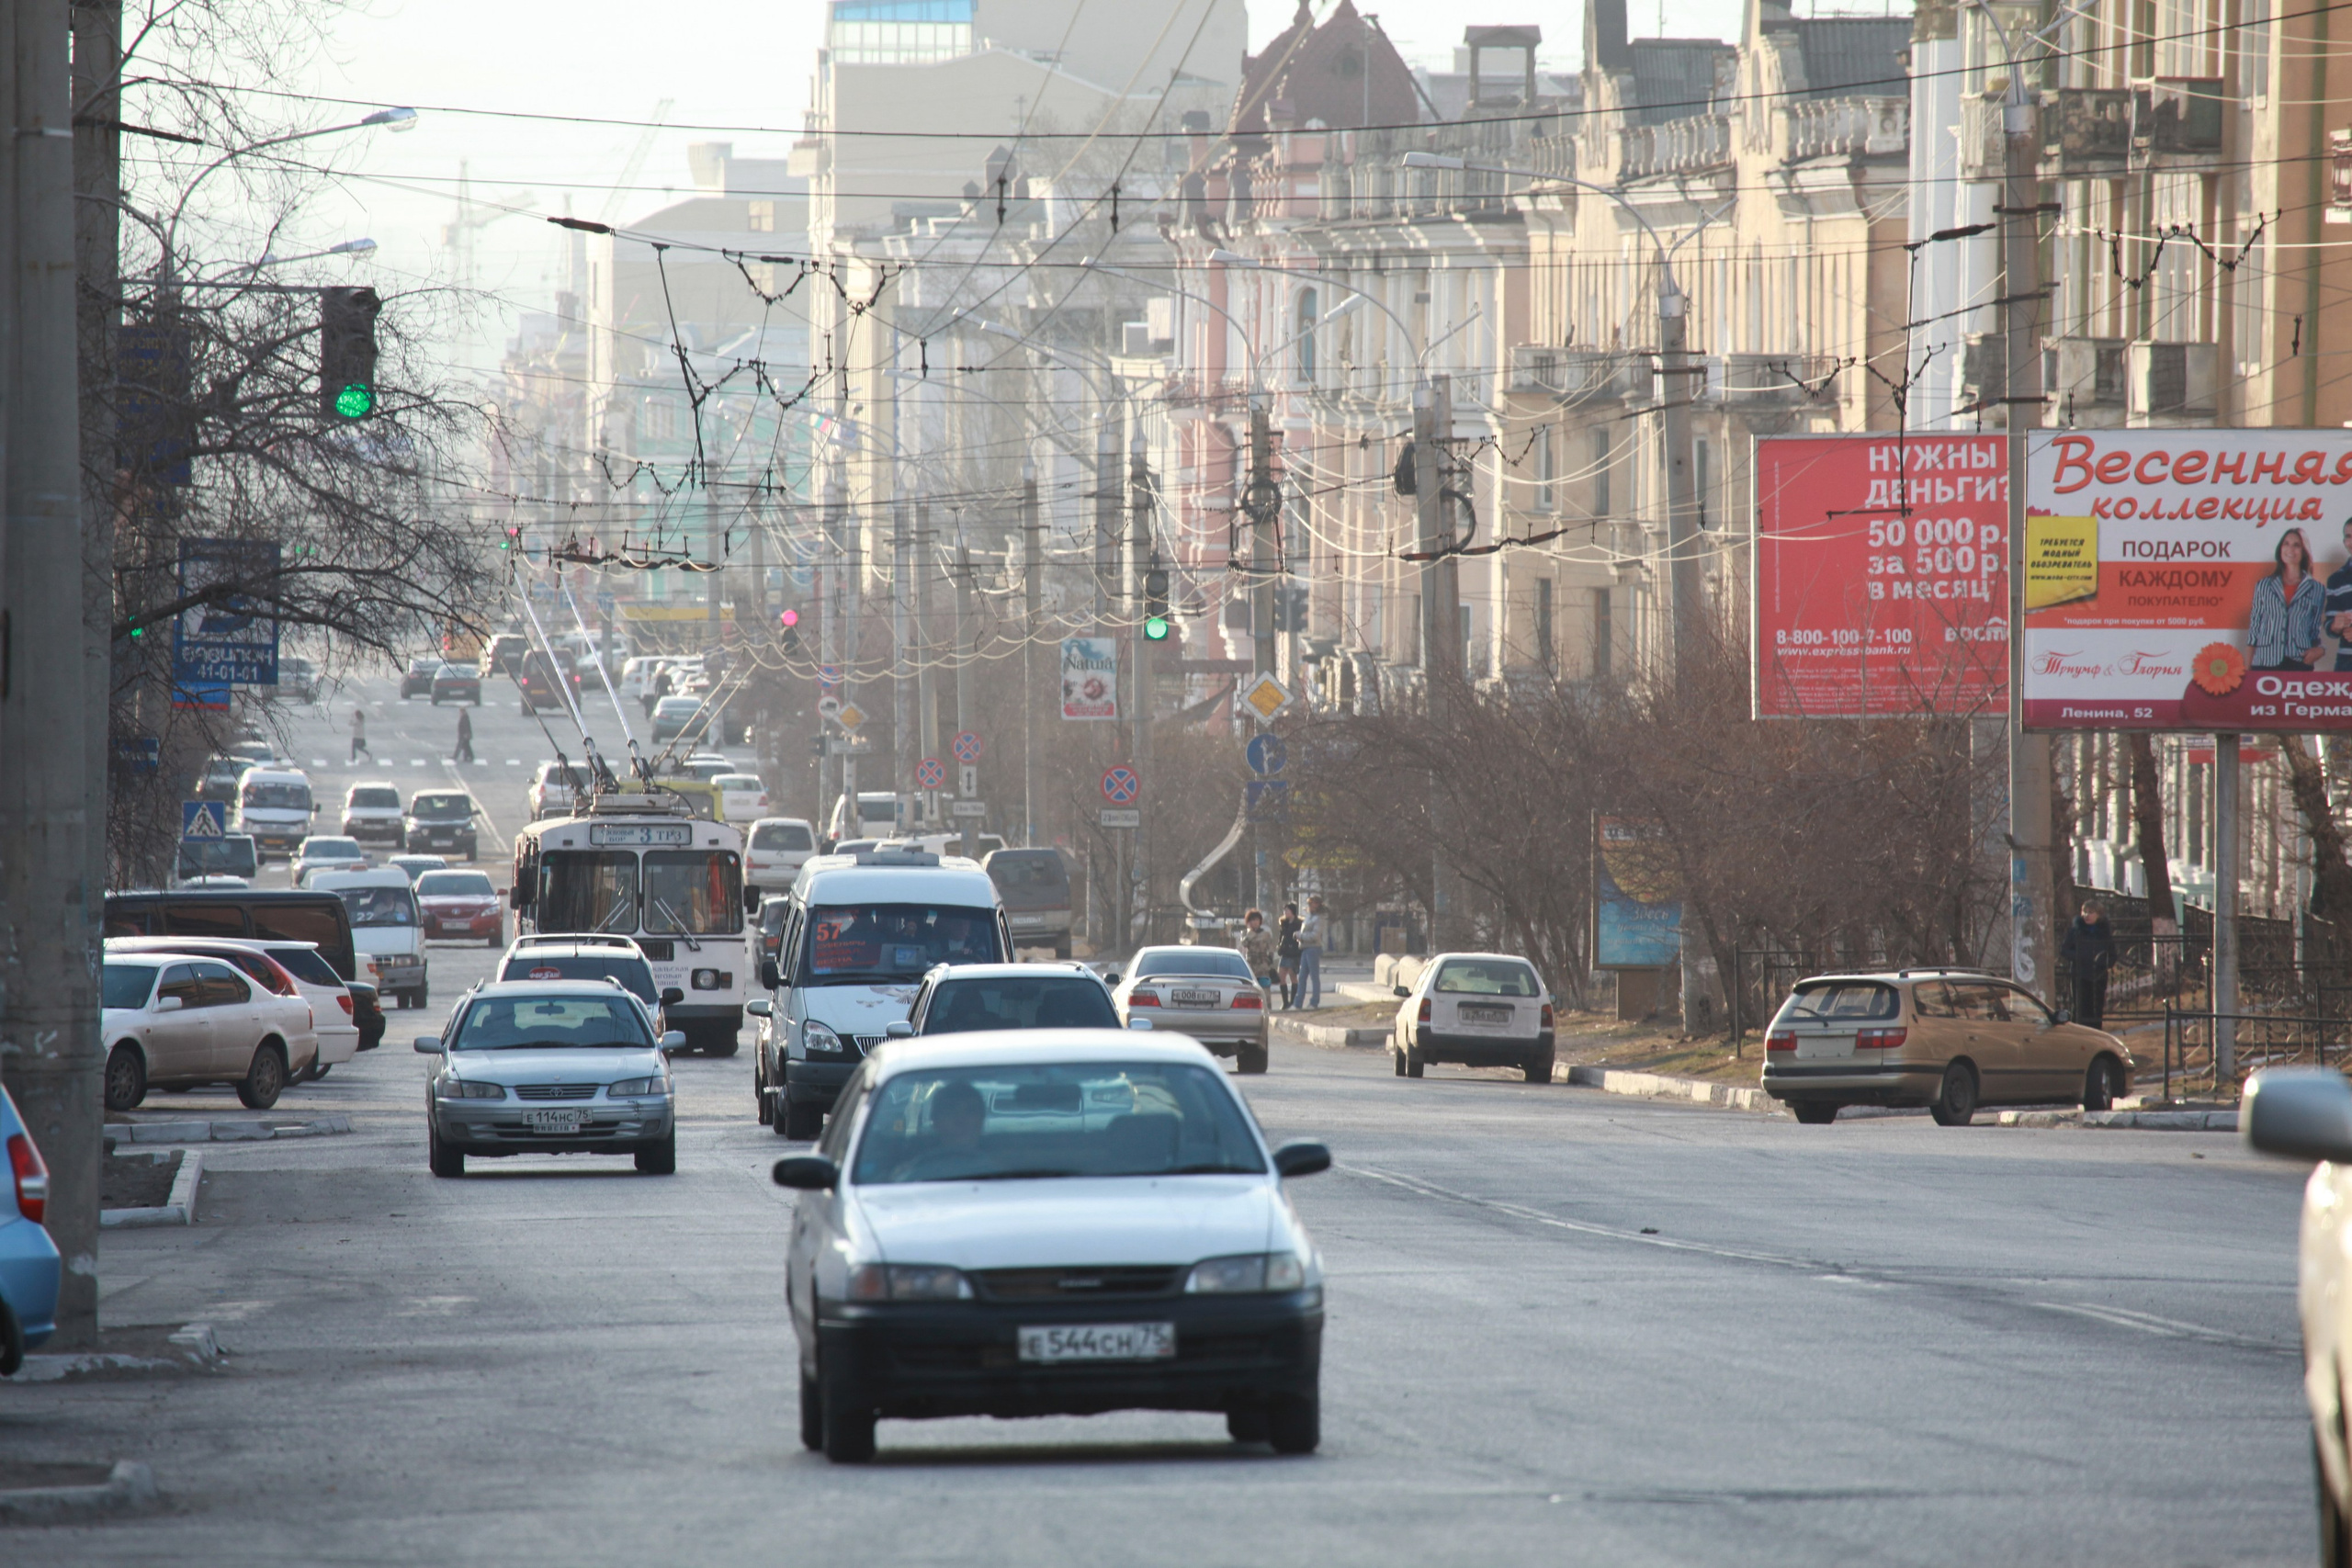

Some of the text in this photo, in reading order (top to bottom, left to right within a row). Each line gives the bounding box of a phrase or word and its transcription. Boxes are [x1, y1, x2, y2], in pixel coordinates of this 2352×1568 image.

[1869, 443, 1996, 472] НУЖНЫ
[2052, 435, 2352, 494] Весенняя
[1865, 476, 2009, 508] ДЕНЬГИ?
[2090, 496, 2324, 528] коллекция
[1868, 517, 2008, 551] 50 000 р.
[2040, 538, 2085, 547] ТРЕБУЕТСЯ
[2041, 548, 2081, 558] МОДНЫЙ
[2121, 540, 2232, 561] ПОДАРОК
[1868, 555, 1905, 575] за
[1917, 546, 1975, 574] 500
[2030, 560, 2093, 569] ОБОЗРЕВАТЕЛЬ
[2119, 570, 2233, 591] КАЖДОМУ
[1869, 581, 1885, 600] в
[2103, 618, 2120, 626] при
[2120, 618, 2154, 626] покупке
[2167, 616, 2187, 625] 5000
[1776, 628, 1913, 645] 8-800-100-7-100
[1944, 621, 2009, 642] вост
[1777, 646, 1911, 658] www.express-bank.ru
[197, 663, 258, 682] 41-01-01
[2030, 649, 2102, 679] Триумф
[2117, 649, 2184, 680] Глория
[2256, 675, 2352, 699] Одеж
[2061, 706, 2154, 719] Ленина, 52
[2250, 705, 2277, 716] из
[639, 827, 652, 844] 3
[356, 912, 375, 921] 22
[816, 922, 843, 942] 57
[817, 940, 866, 949] СУВЕНИРЫ
[817, 957, 853, 966] ВЕСНА
